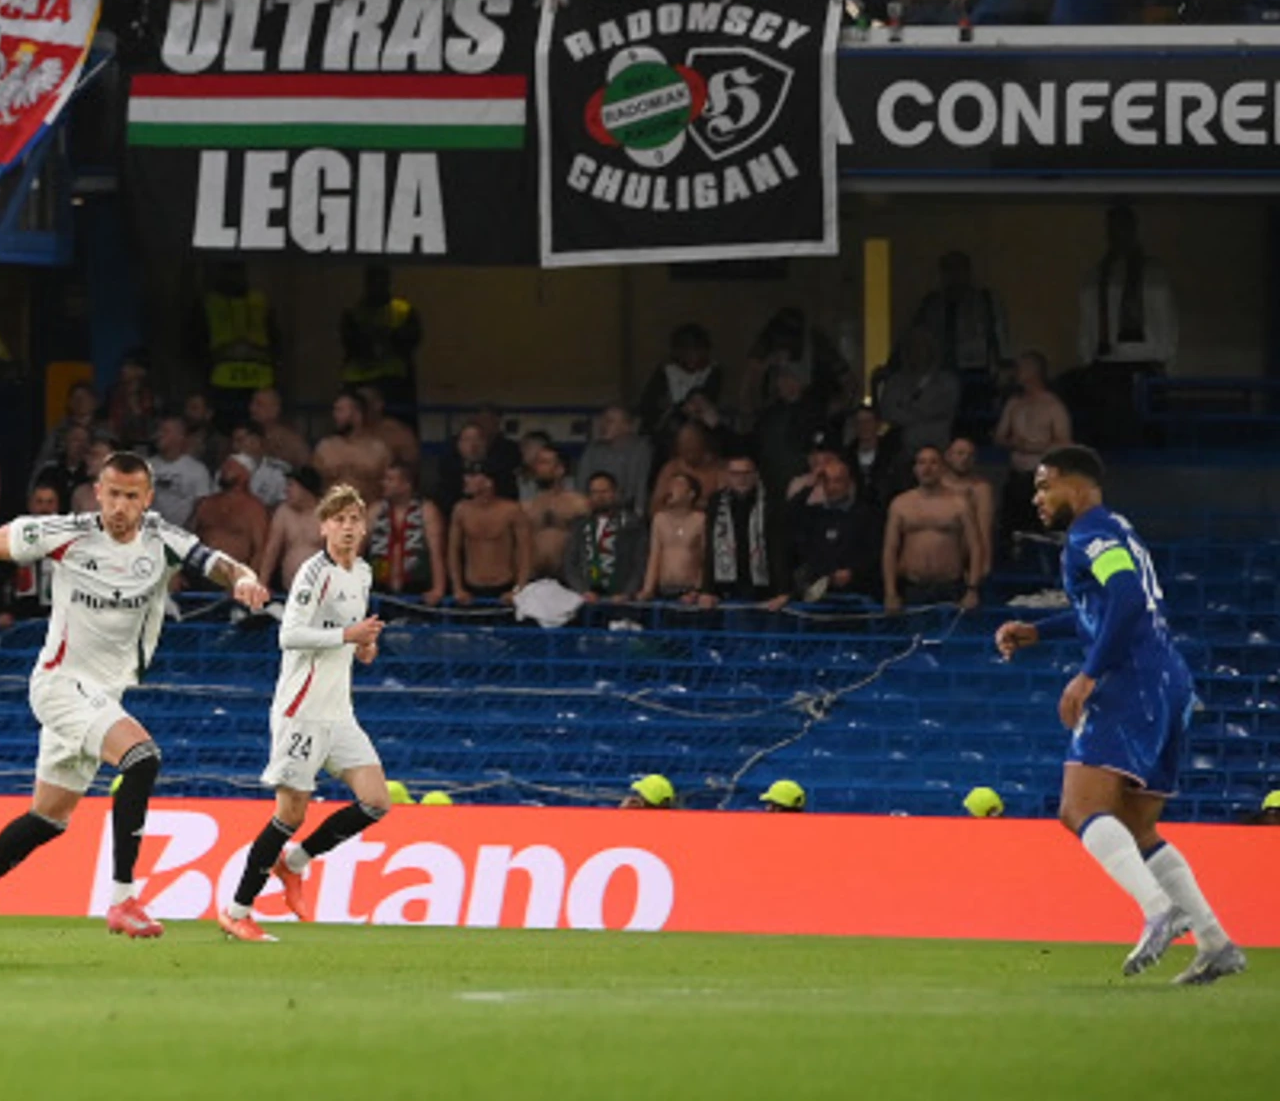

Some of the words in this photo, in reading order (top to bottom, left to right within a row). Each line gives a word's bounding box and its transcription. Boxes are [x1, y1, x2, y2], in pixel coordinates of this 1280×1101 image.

[563, 2, 811, 62] RADOMSCY
[876, 79, 1280, 147] CONFERE
[192, 147, 448, 254] LEGIA
[566, 144, 799, 212] CHULIGANI
[288, 732, 312, 761] 24
